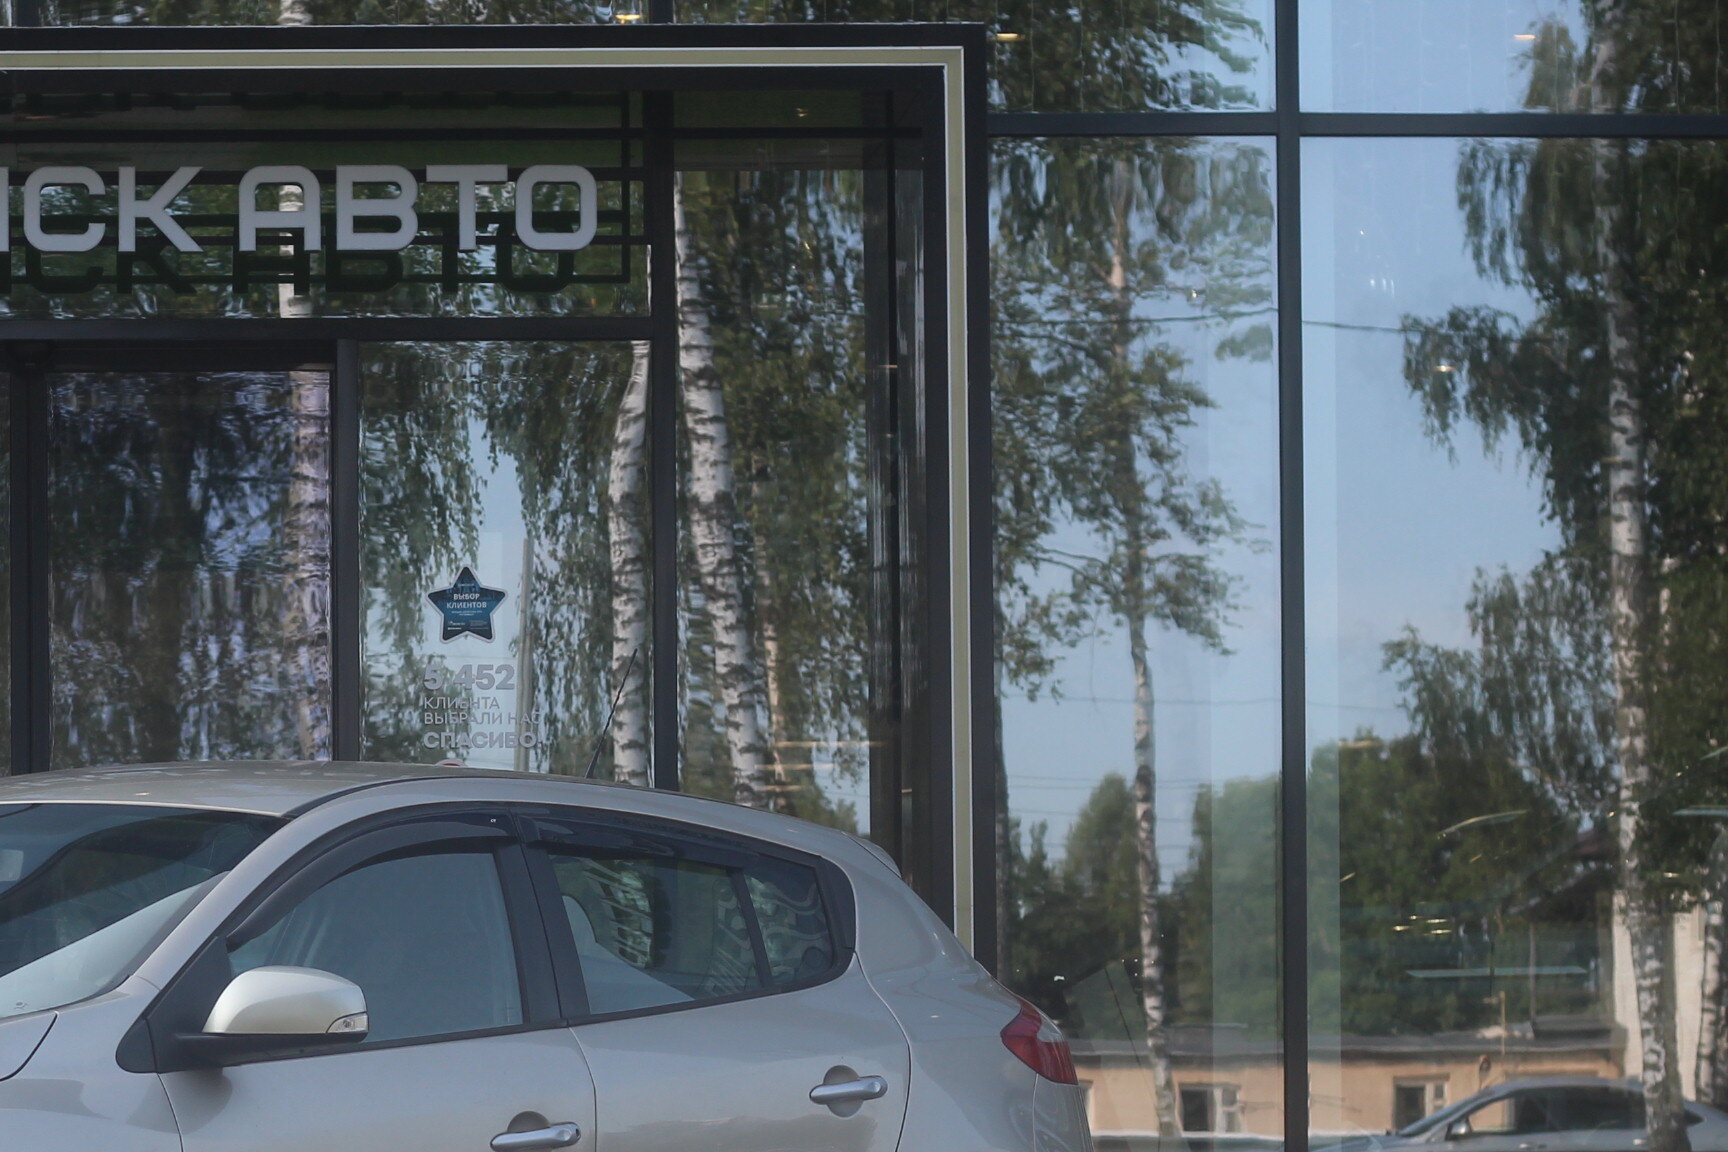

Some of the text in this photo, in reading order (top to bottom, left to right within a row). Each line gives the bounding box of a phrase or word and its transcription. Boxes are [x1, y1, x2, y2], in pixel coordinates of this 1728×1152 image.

[238, 164, 599, 252] АВТО
[446, 601, 487, 609] КЛИЕНТОВ
[453, 664, 515, 690] 452
[424, 697, 500, 709] КЛИЕНТА
[424, 712, 541, 724] ВЫБРАЛИ НАС
